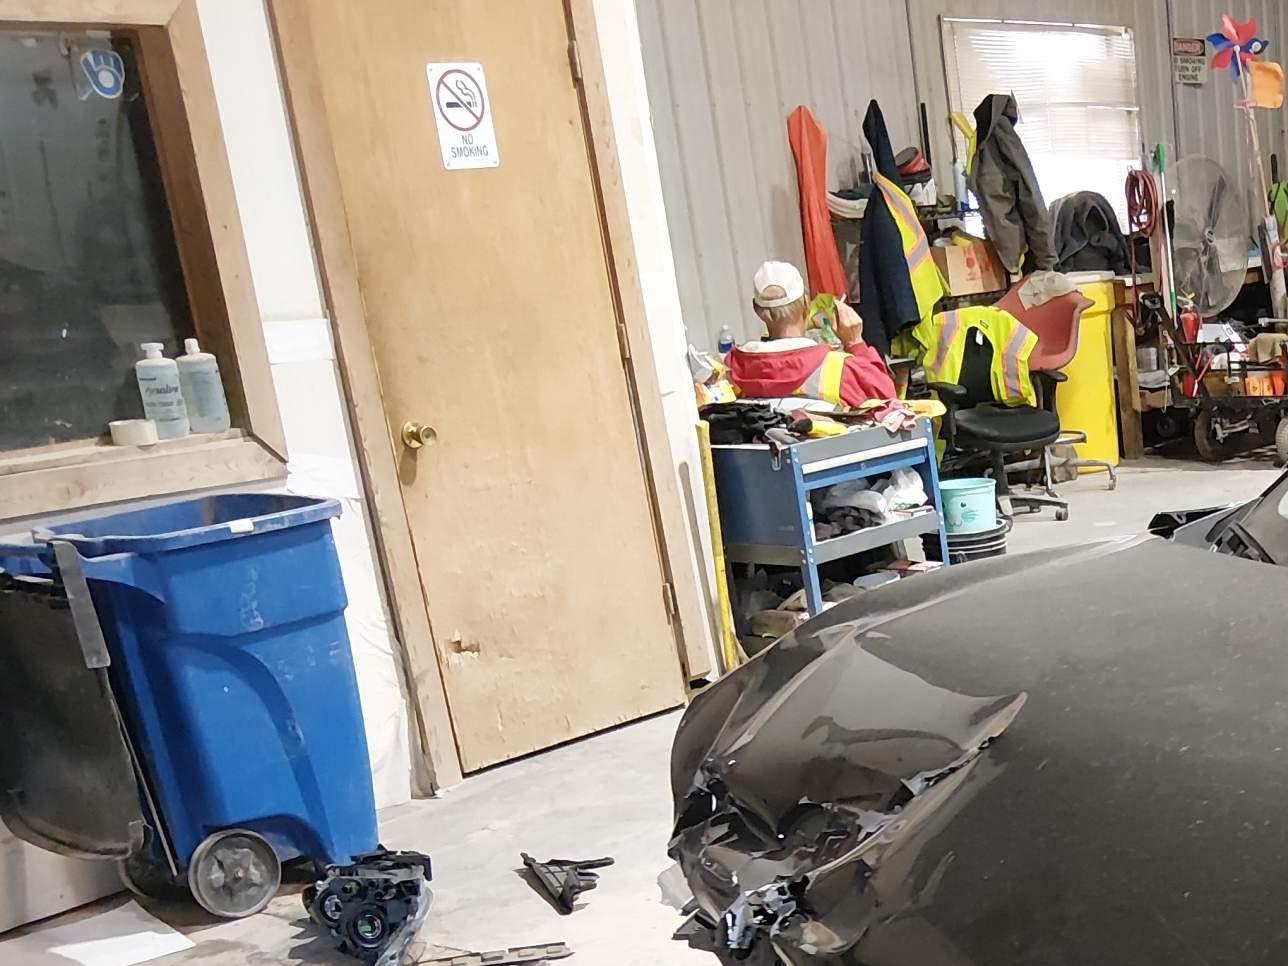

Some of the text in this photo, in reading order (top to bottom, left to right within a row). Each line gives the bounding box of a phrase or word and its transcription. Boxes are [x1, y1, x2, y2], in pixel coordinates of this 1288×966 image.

[1191, 65, 1202, 73] OFF
[460, 133, 474, 145] NO
[450, 144, 489, 159] SMOKING
